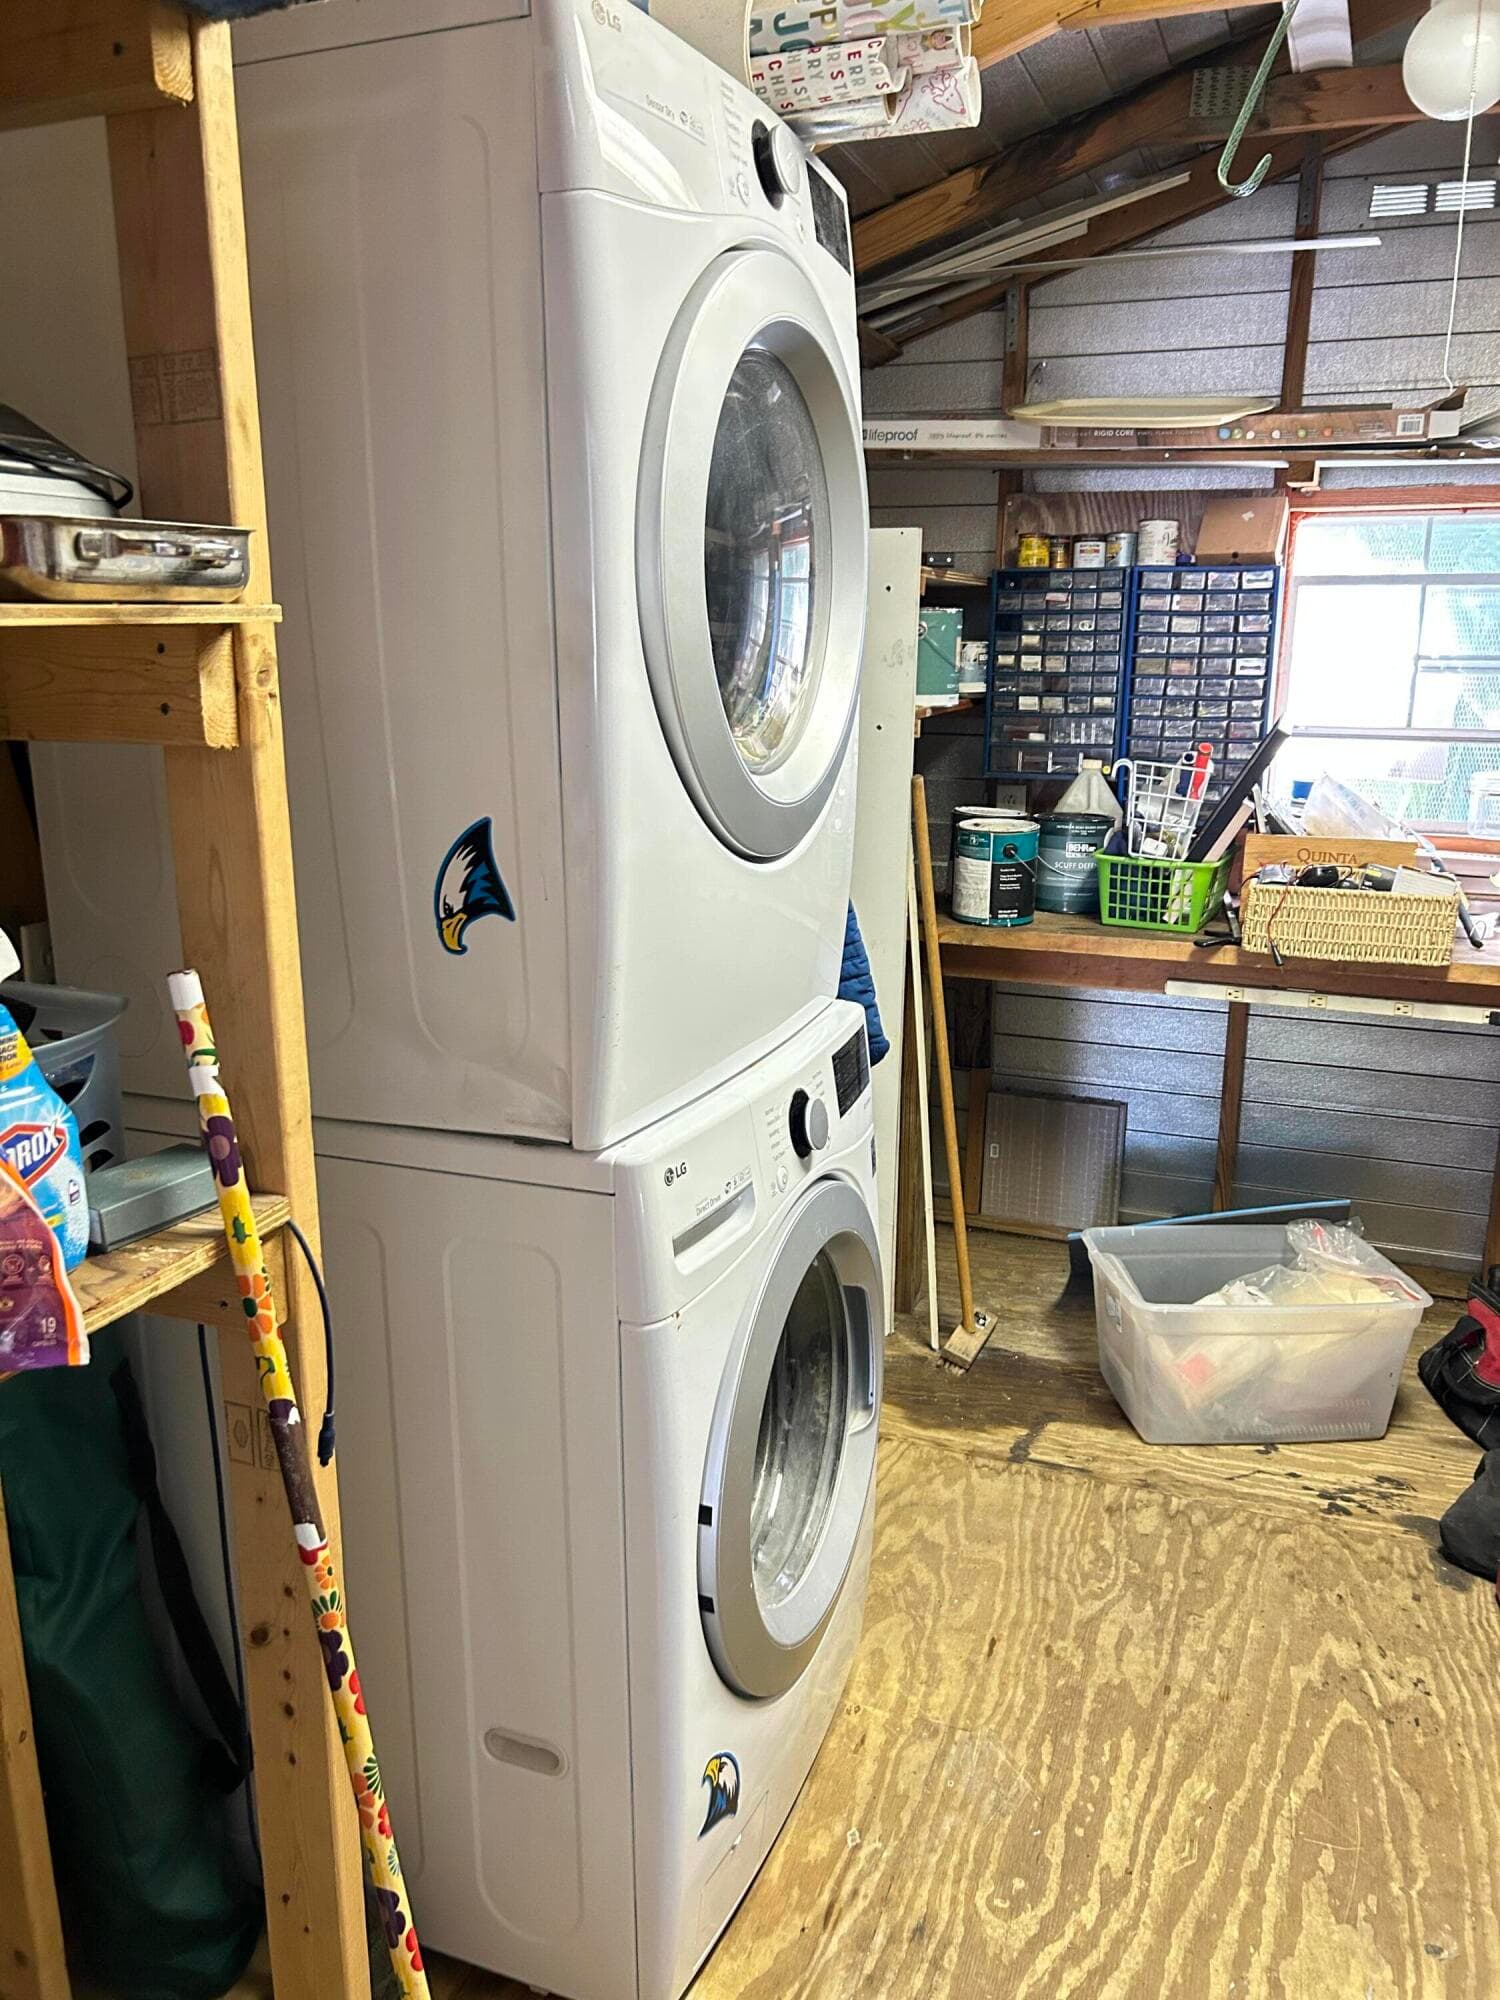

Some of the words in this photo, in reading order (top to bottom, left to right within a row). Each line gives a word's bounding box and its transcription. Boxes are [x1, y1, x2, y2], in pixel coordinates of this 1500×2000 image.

[868, 428, 918, 443] lifeproof
[1115, 429, 1134, 437] CORE
[1297, 848, 1358, 864] QUINTA
[1055, 861, 1076, 869] SCUFF
[10, 1119, 59, 1170] ROX
[41, 1316, 57, 1334] 19
